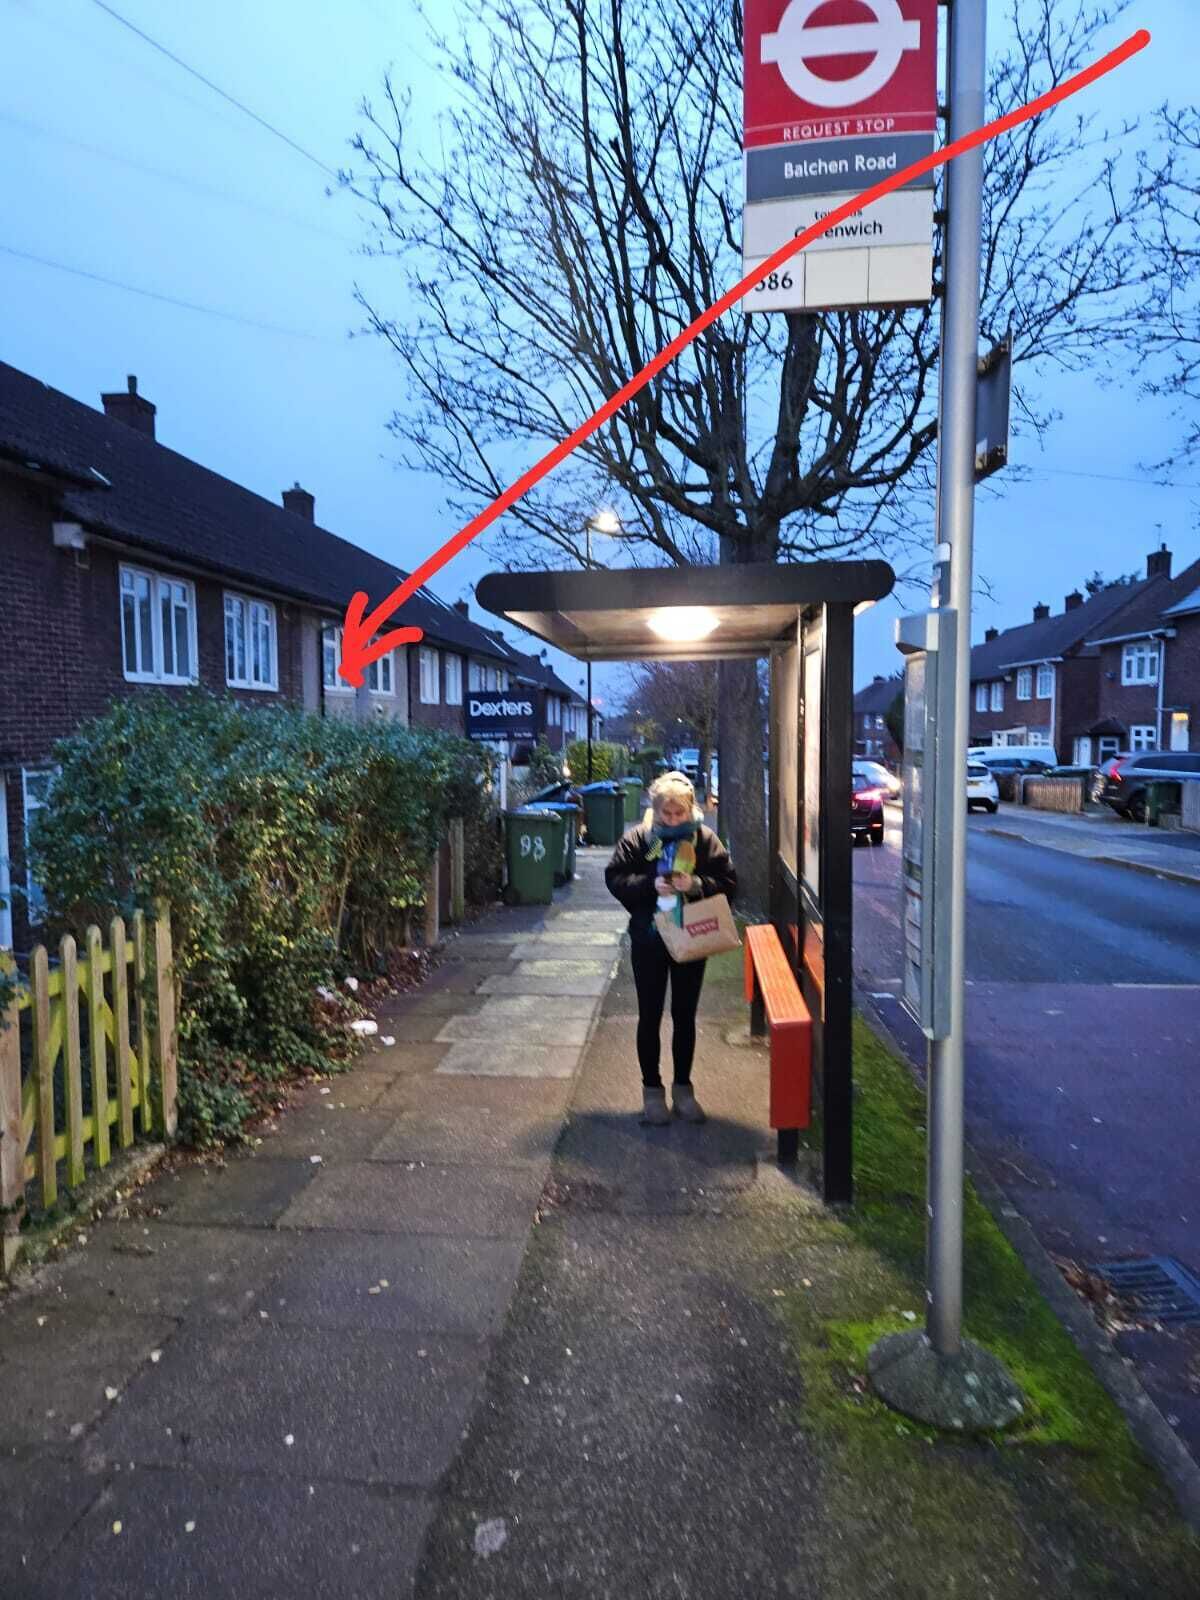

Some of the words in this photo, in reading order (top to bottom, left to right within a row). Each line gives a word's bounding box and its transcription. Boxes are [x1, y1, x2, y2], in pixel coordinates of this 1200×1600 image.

[783, 121, 850, 141] REQUEST
[856, 118, 895, 133] STOP
[784, 158, 849, 179] Balchen
[855, 152, 897, 172] Road
[470, 699, 533, 717] Dexters
